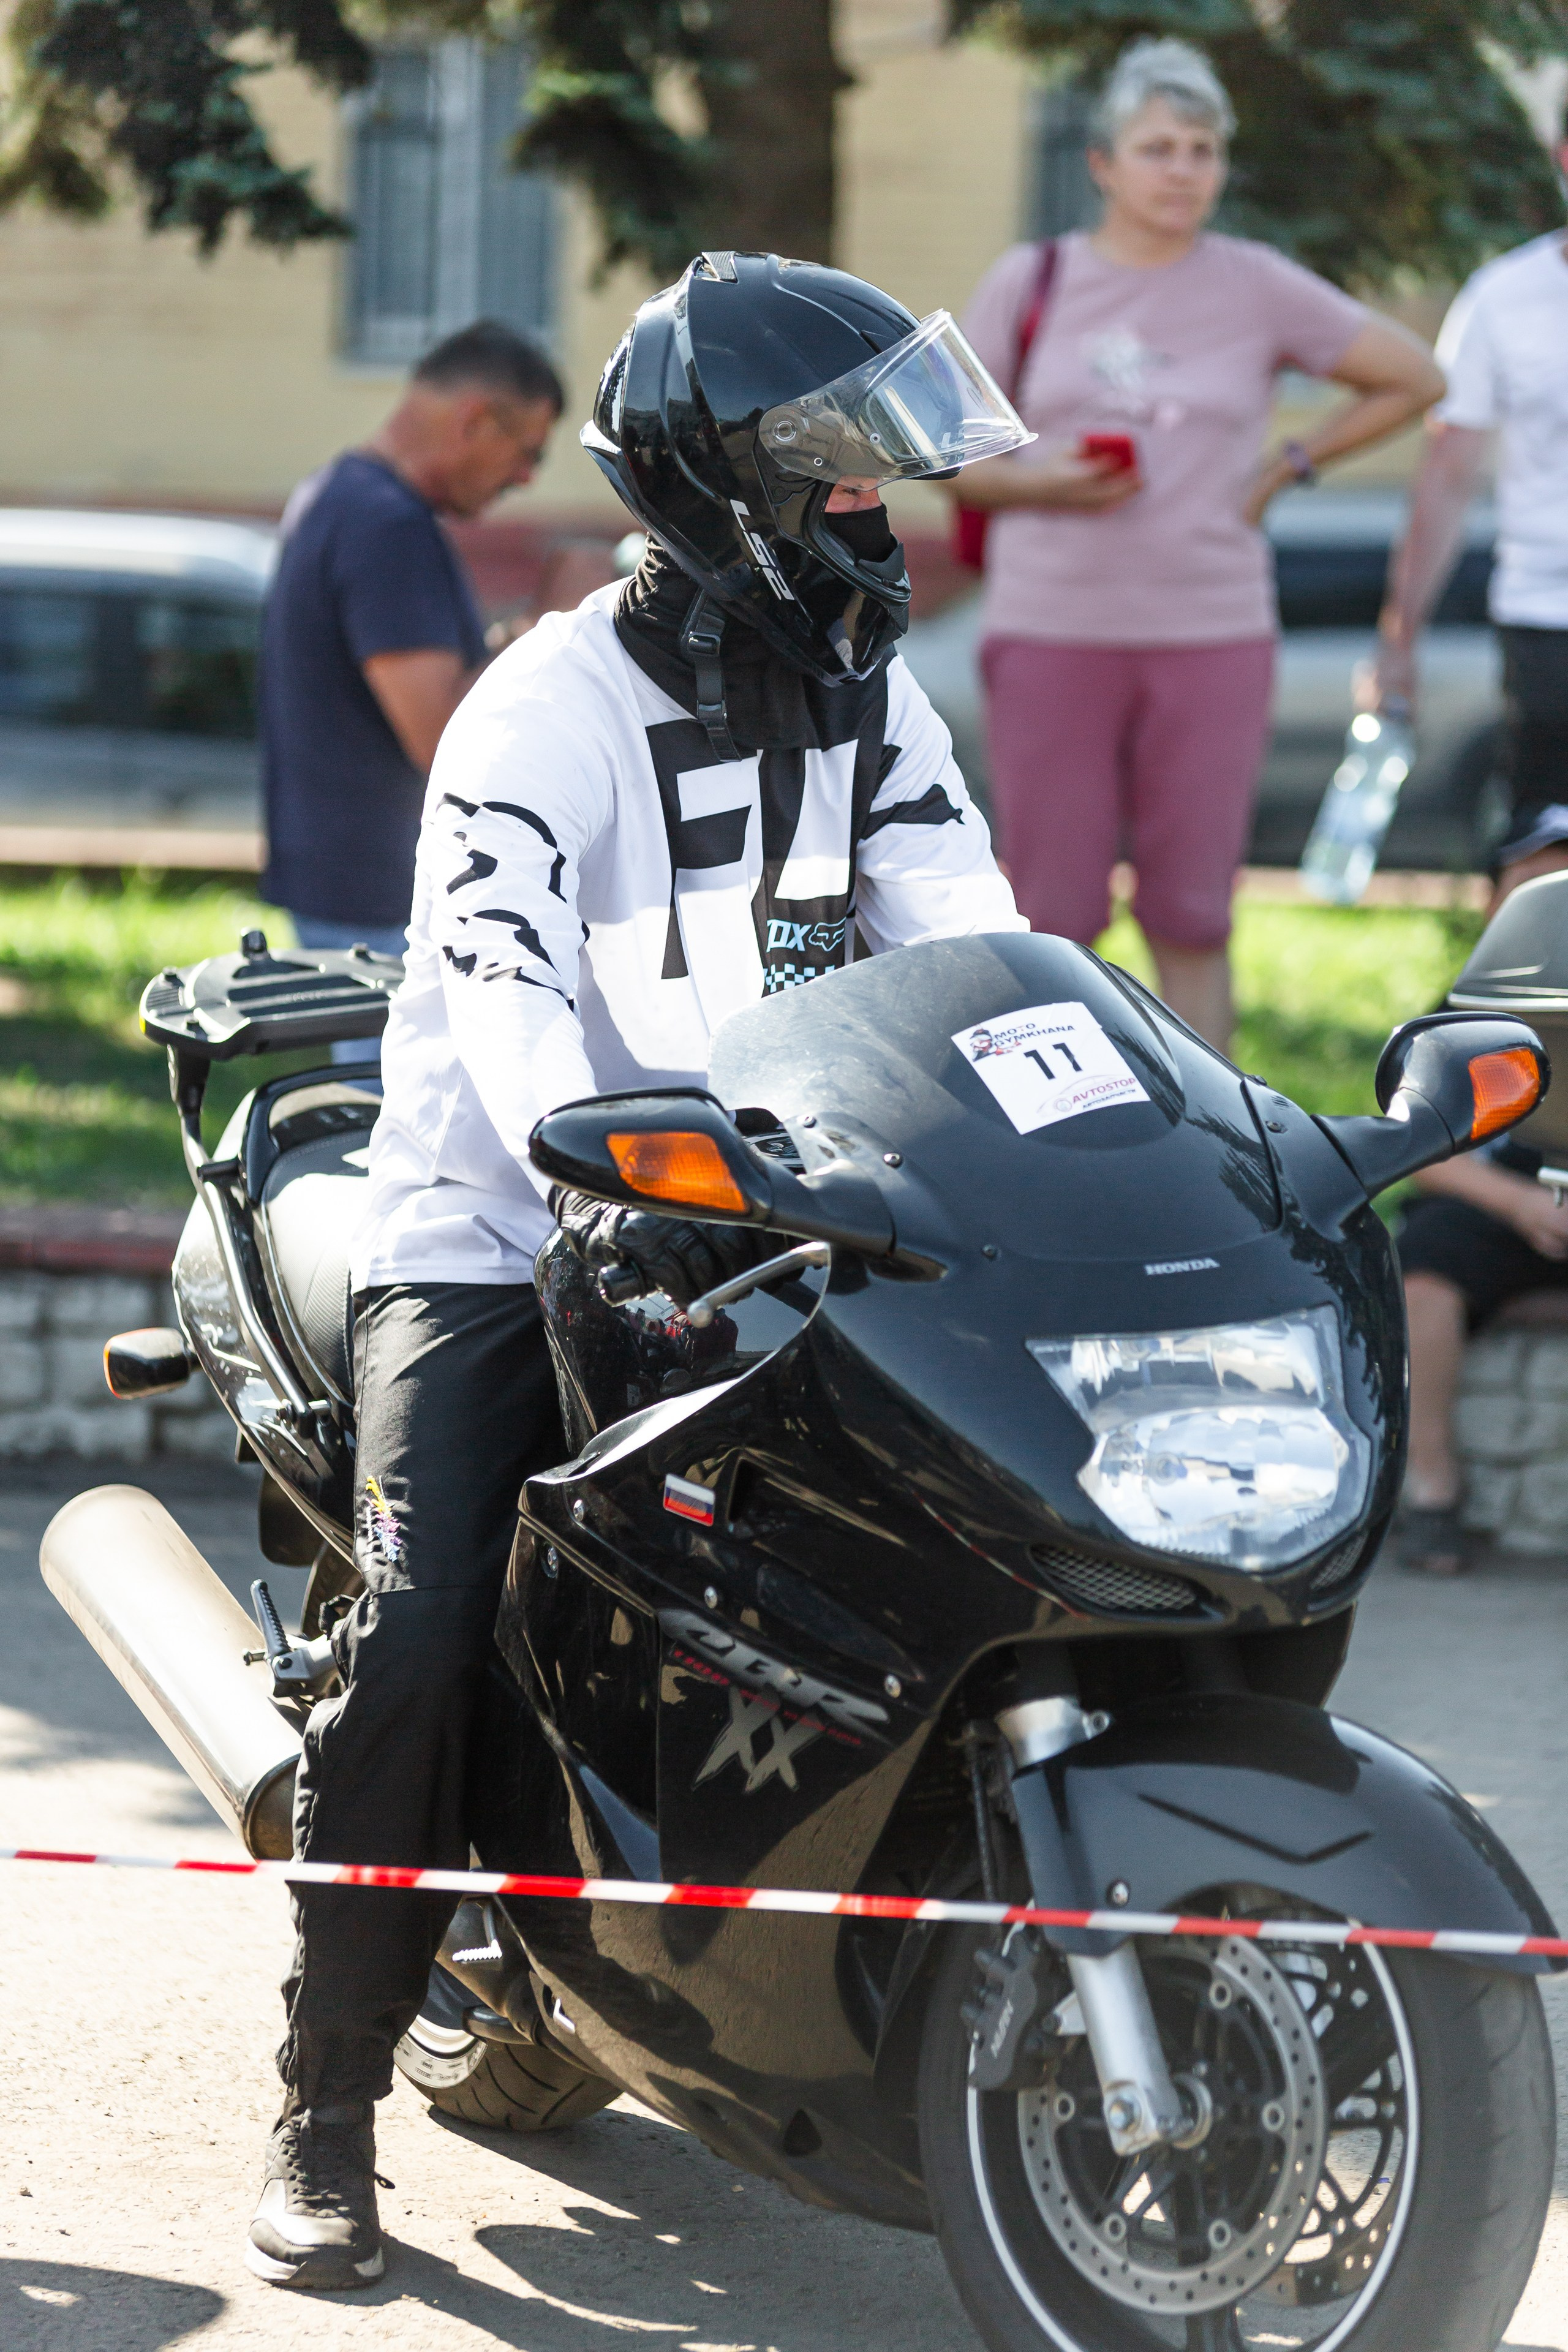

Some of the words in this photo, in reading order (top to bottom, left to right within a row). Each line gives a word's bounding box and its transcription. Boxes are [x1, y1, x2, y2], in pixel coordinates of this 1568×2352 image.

[730, 499, 795, 601] LS2
[994, 1023, 1036, 1040] MOTO
[994, 1025, 1076, 1047] GYMKHANA
[1023, 1042, 1083, 1080] 11
[1145, 1257, 1220, 1276] HONDA
[693, 1683, 824, 1795] XX
